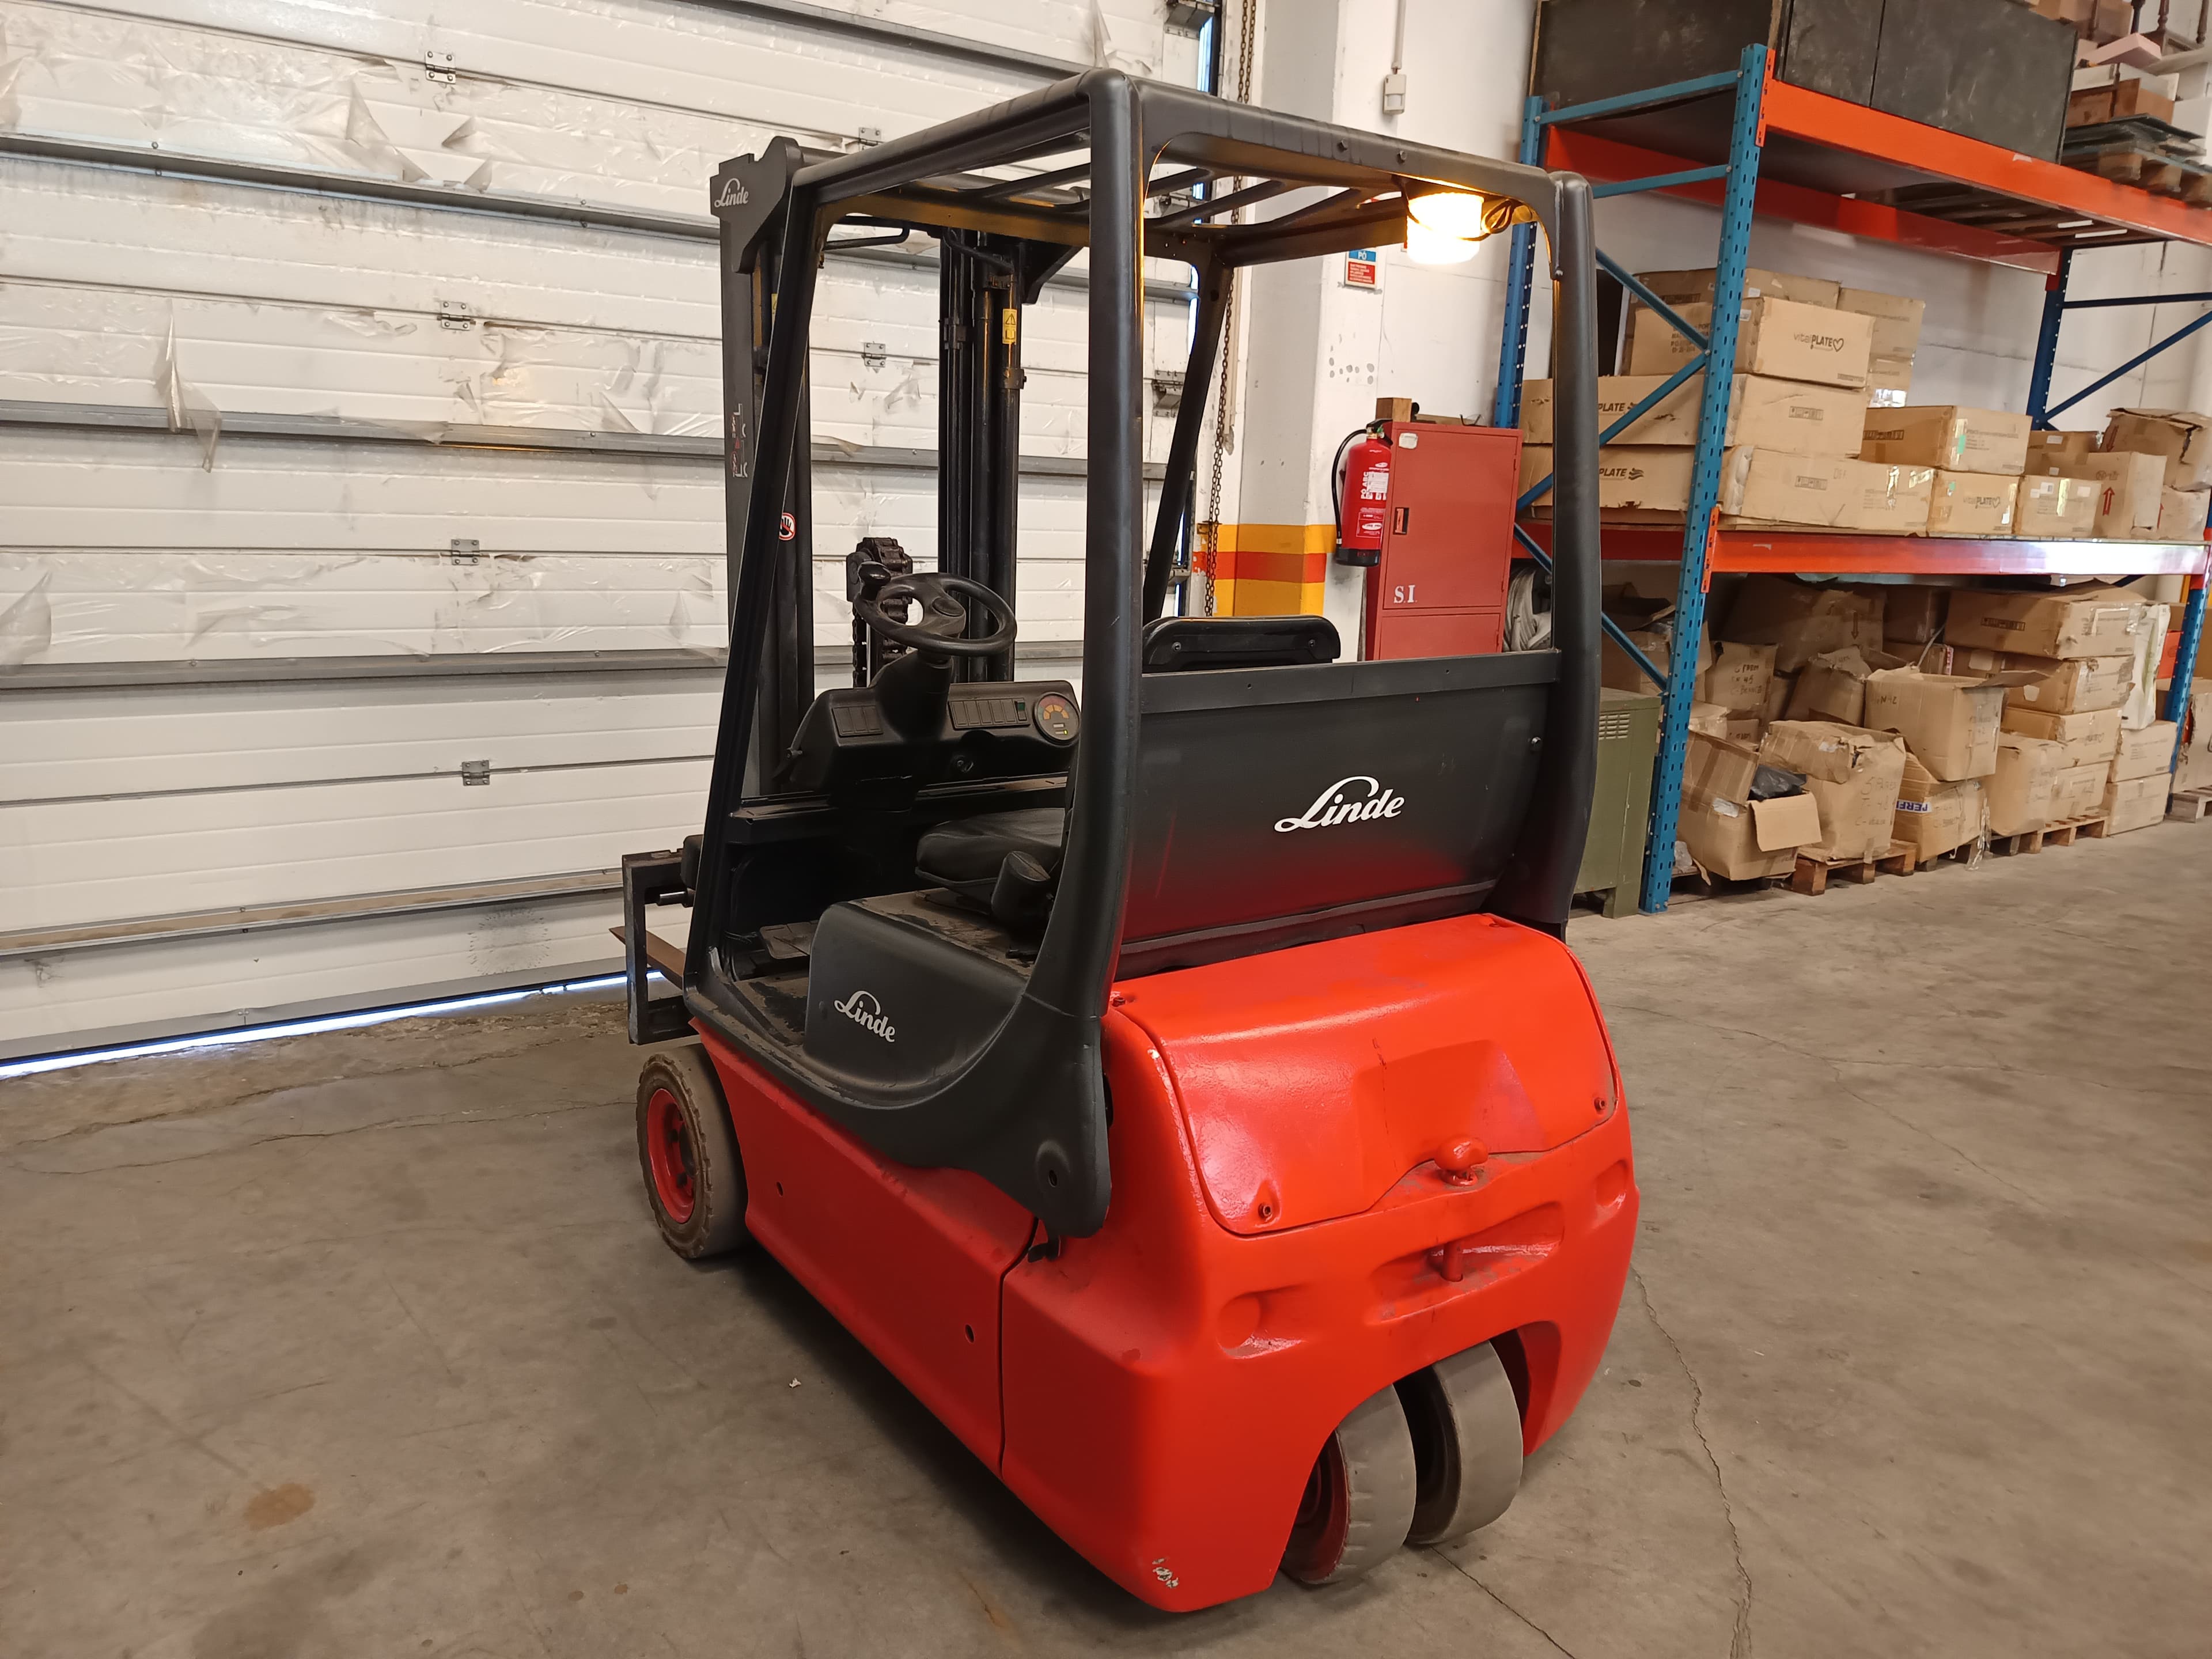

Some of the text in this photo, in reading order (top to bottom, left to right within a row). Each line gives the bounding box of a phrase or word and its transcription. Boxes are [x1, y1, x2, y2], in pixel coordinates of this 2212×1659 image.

[714, 177, 749, 207] Linde
[1274, 775, 1405, 832] Linde
[834, 990, 896, 1042] Linde
